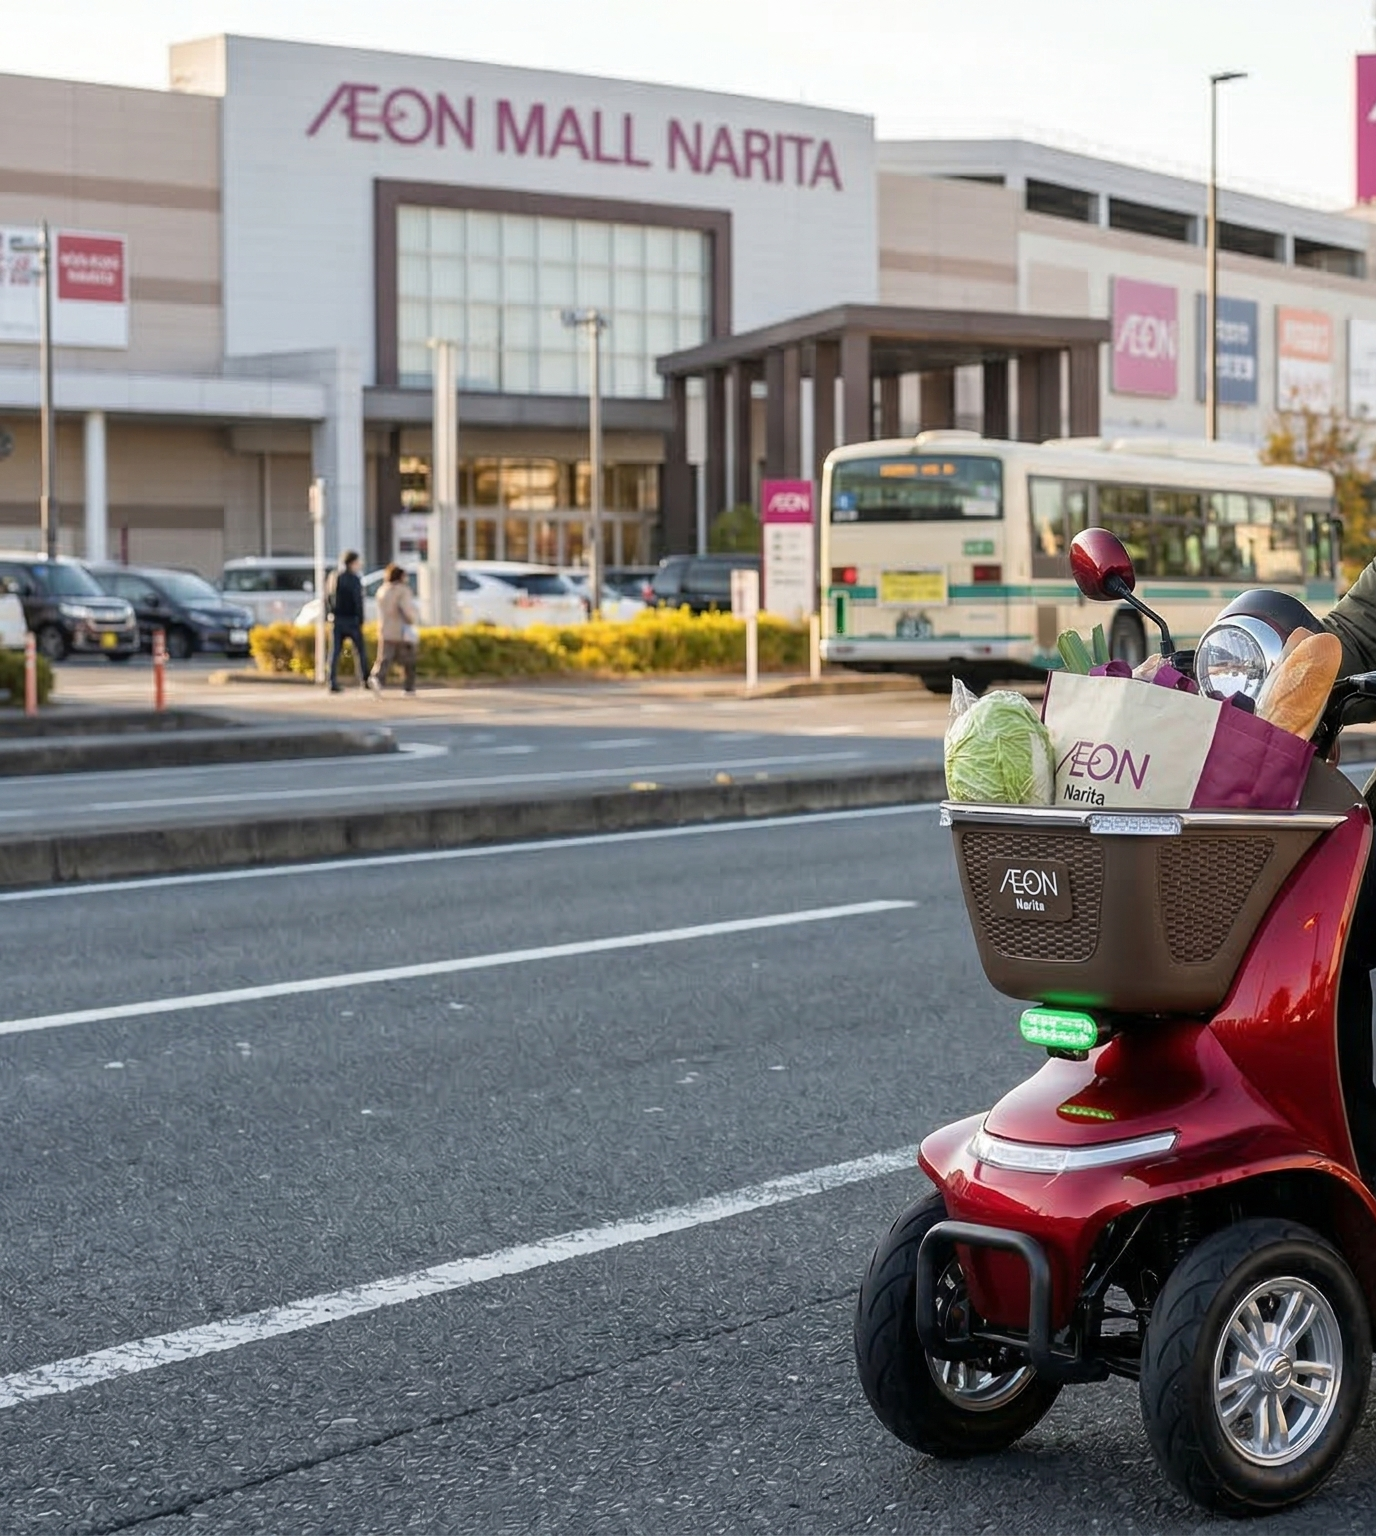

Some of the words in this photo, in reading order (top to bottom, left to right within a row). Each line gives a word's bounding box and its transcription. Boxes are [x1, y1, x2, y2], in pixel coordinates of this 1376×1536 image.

[496, 97, 652, 168] MALL
[667, 116, 842, 191] NARITA
[1063, 784, 1105, 806] Narita
